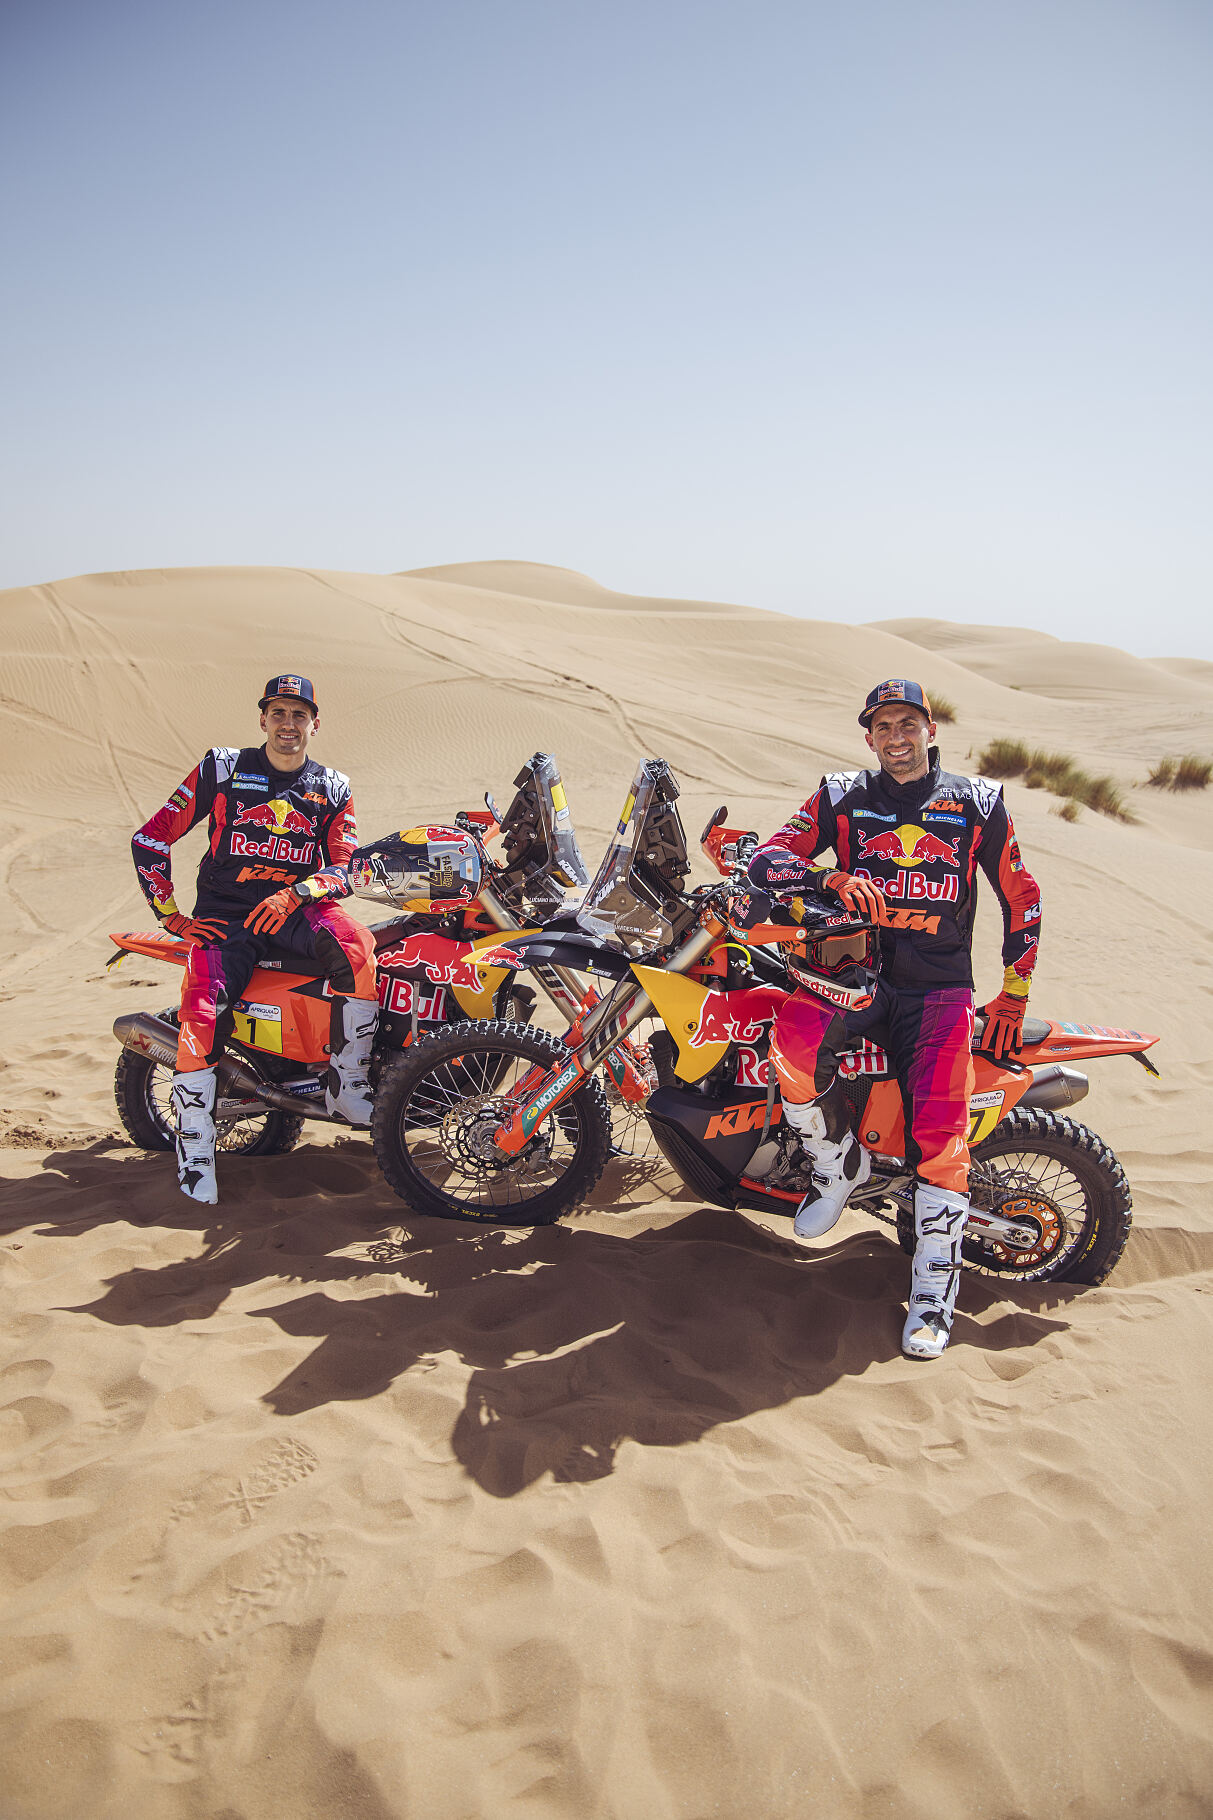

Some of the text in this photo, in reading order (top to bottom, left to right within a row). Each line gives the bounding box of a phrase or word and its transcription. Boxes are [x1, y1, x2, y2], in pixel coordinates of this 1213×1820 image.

[303, 792, 327, 805] KTM
[928, 800, 963, 812] KTM
[132, 833, 170, 855] KTM
[230, 831, 277, 859] Red
[275, 838, 316, 864] Bull
[236, 864, 297, 887] KTM
[767, 868, 806, 881] Red Bull
[907, 871, 959, 903] Bull
[826, 913, 848, 926] Red
[388, 978, 448, 1021] Bull
[246, 1018, 256, 1044] 1
[148, 1044, 178, 1067] AKRAP
[535, 1066, 578, 1110] MOTOREX
[704, 1099, 783, 1140] KTM
